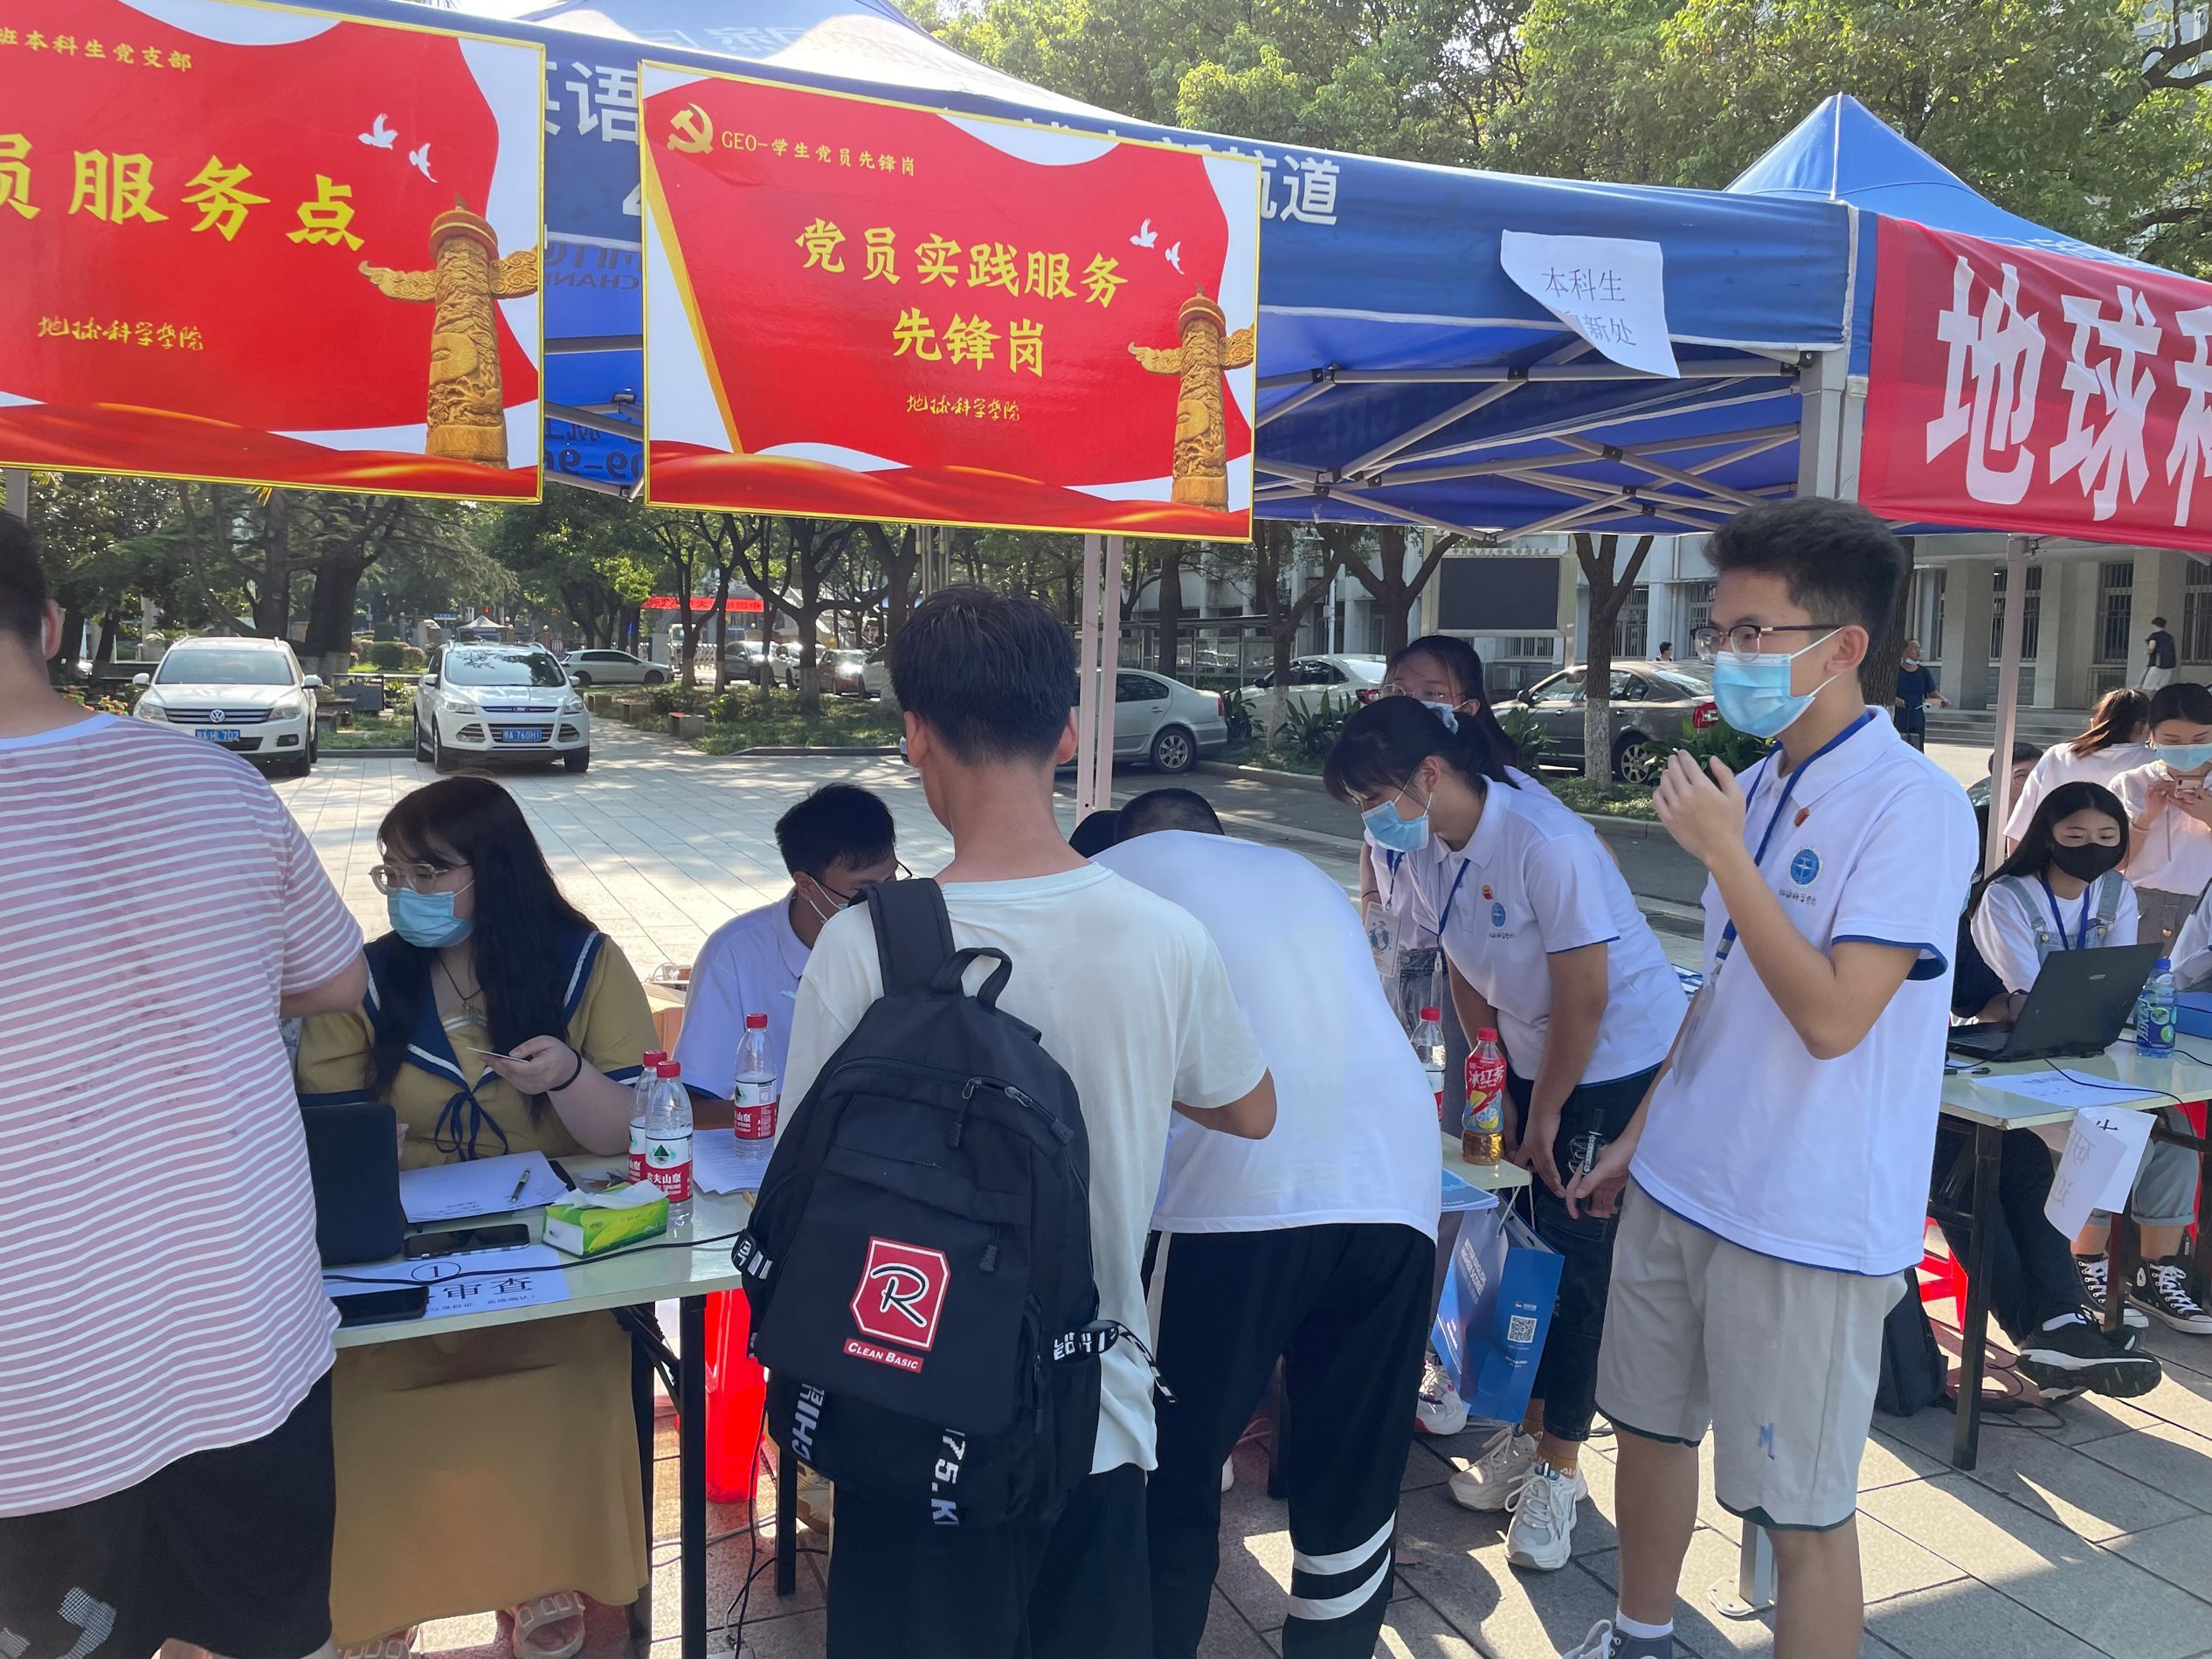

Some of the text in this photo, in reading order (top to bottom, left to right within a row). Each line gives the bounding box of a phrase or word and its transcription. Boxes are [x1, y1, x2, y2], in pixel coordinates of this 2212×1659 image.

[794, 218, 1129, 308] 党员实践服务
[1541, 266, 1625, 302] 本科生
[892, 307, 1044, 377] 先锋岗
[1469, 1065, 1504, 1089] 冰红茶
